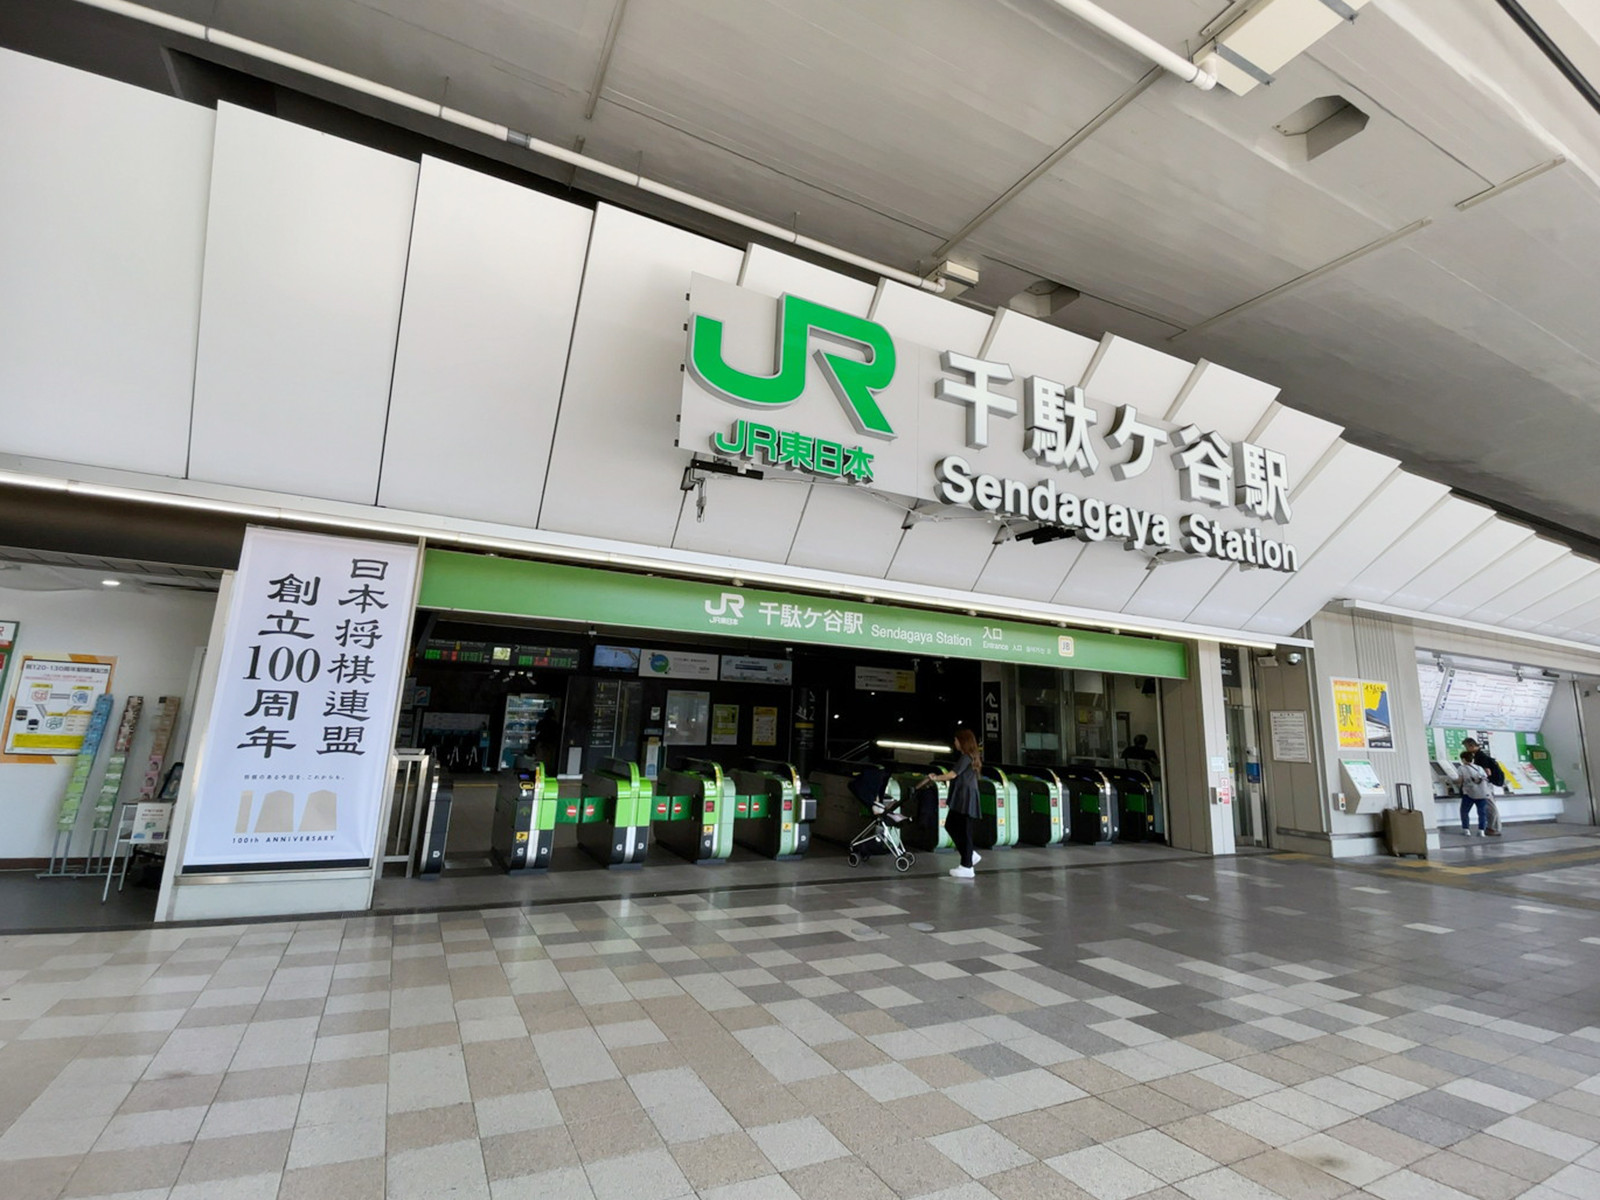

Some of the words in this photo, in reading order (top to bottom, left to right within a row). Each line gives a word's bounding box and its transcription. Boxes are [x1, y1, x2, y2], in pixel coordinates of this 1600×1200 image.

[690, 293, 898, 439] JR
[712, 419, 874, 482] JR東日本
[938, 455, 1171, 550] Sendagaya
[1183, 513, 1299, 572] Station
[705, 592, 745, 618] JR
[871, 624, 933, 645] Sendagaya
[936, 631, 972, 647] Station
[982, 626, 1003, 641] 入口
[982, 641, 1009, 651] Entrance
[236, 573, 321, 759] 創立100周年
[317, 558, 389, 756] 日本将棋連盟
[265, 835, 335, 843] ANNIVERSARY
